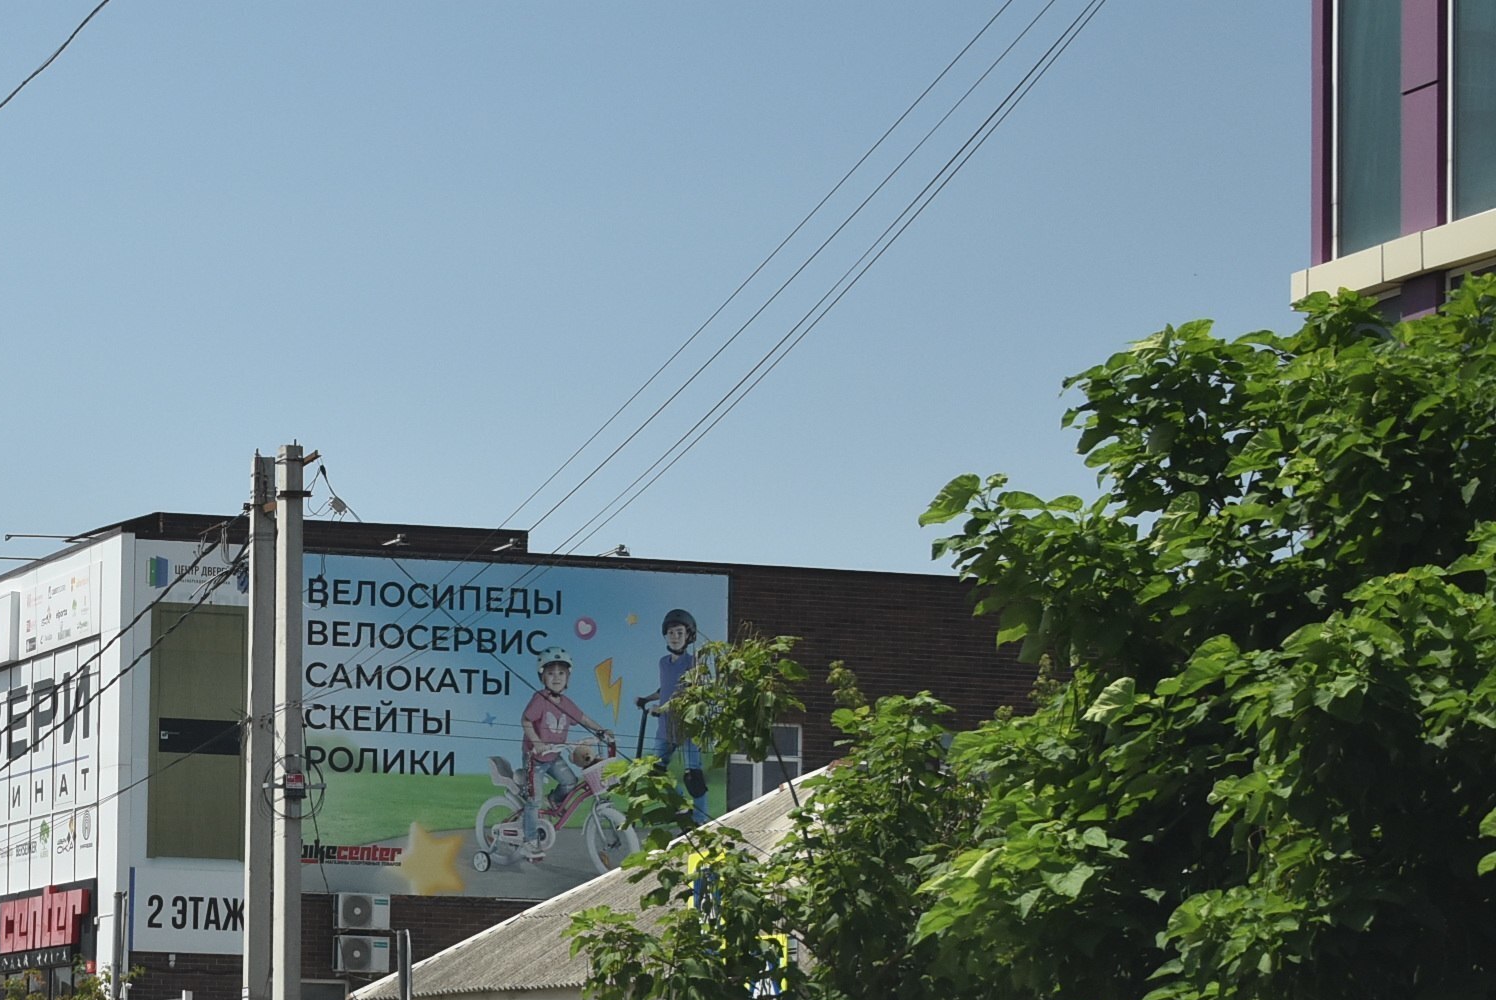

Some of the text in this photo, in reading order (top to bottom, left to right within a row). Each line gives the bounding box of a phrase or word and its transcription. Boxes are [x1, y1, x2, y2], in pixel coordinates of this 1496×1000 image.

[308, 578, 562, 617] ВЕЛОСИПЕДЫ
[307, 620, 548, 655] ВЕЛОСЕРВИС
[306, 662, 510, 696] САМОКАТЫ
[305, 700, 451, 735] СКЕЙТЫ
[306, 746, 455, 776] РОЛИКИ
[147, 895, 244, 931] 2 ЭТАЖ
